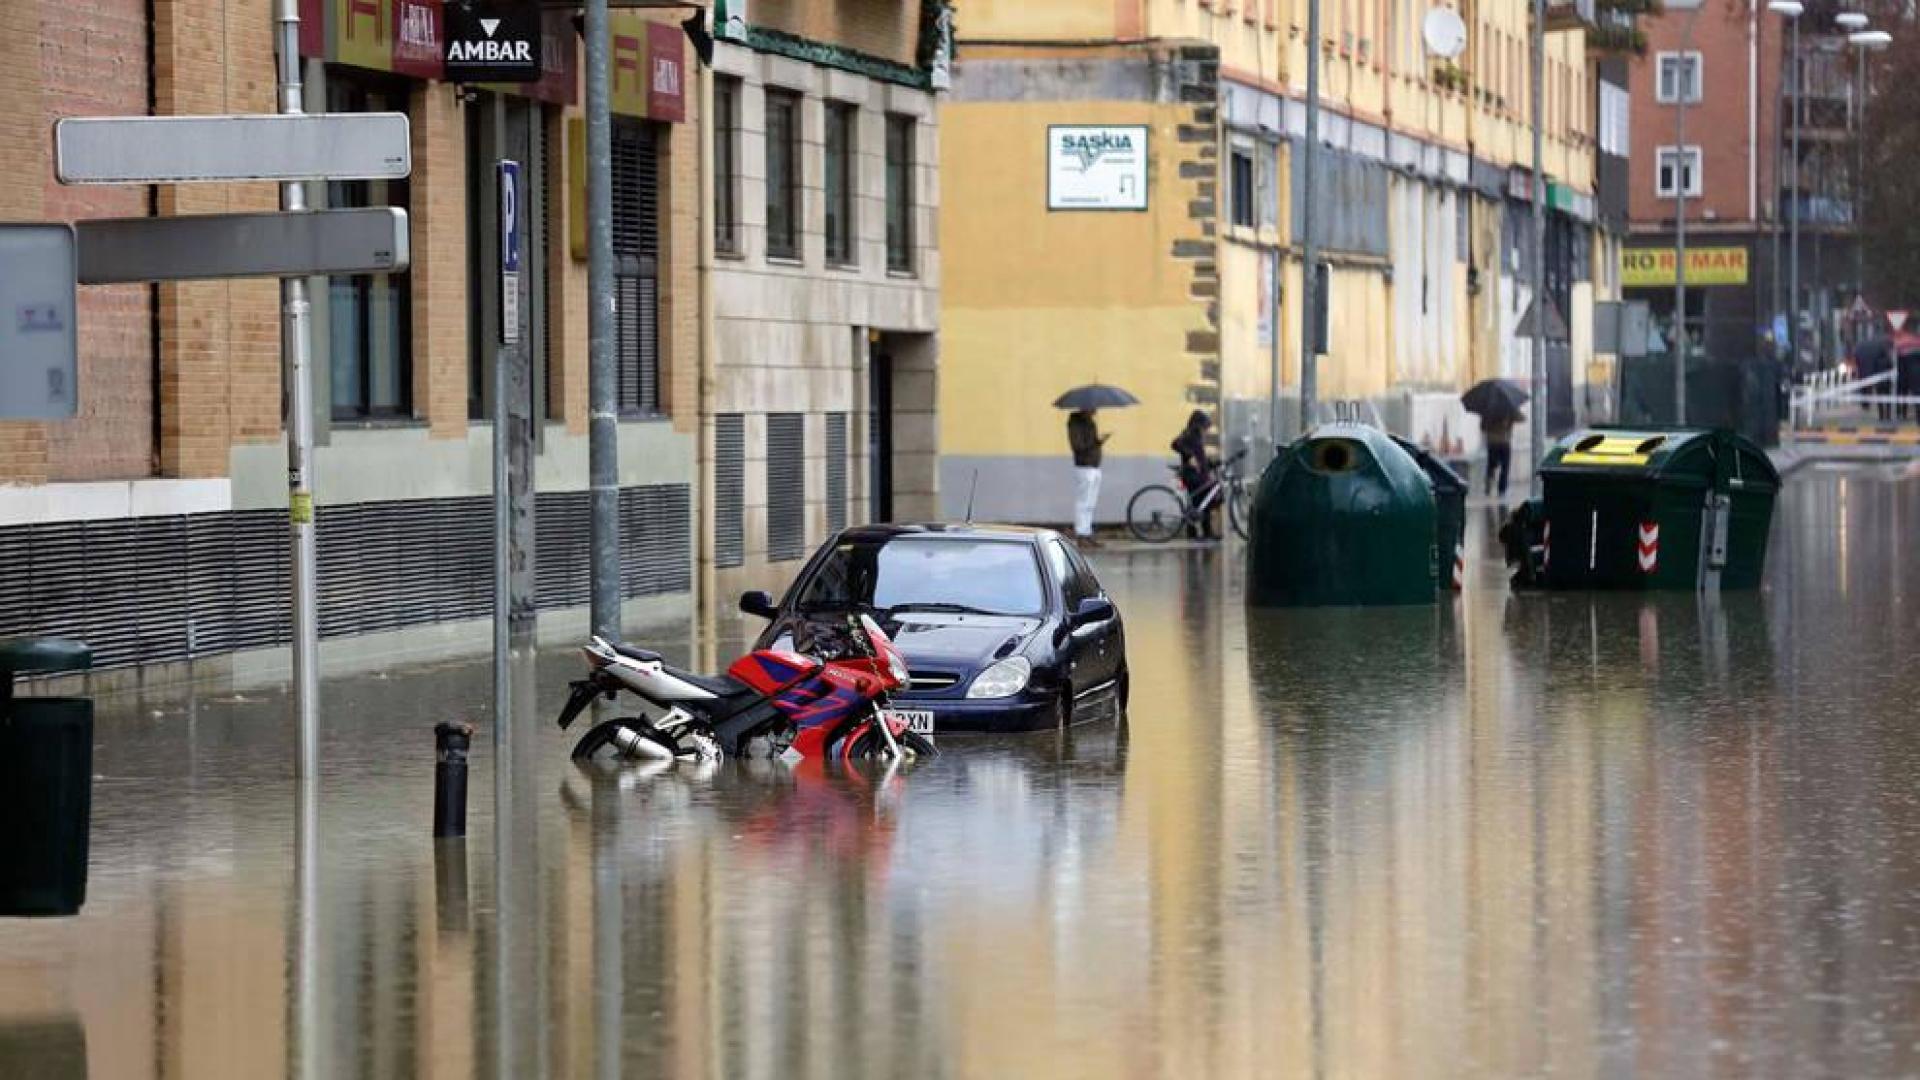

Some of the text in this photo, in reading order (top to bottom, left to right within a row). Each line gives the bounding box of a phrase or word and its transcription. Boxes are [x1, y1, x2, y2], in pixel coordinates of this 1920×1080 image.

[448, 40, 531, 62] AMBAR
[1062, 132, 1132, 149] SASKIA
[505, 172, 515, 264] P
[1659, 253, 1744, 271] RMAR
